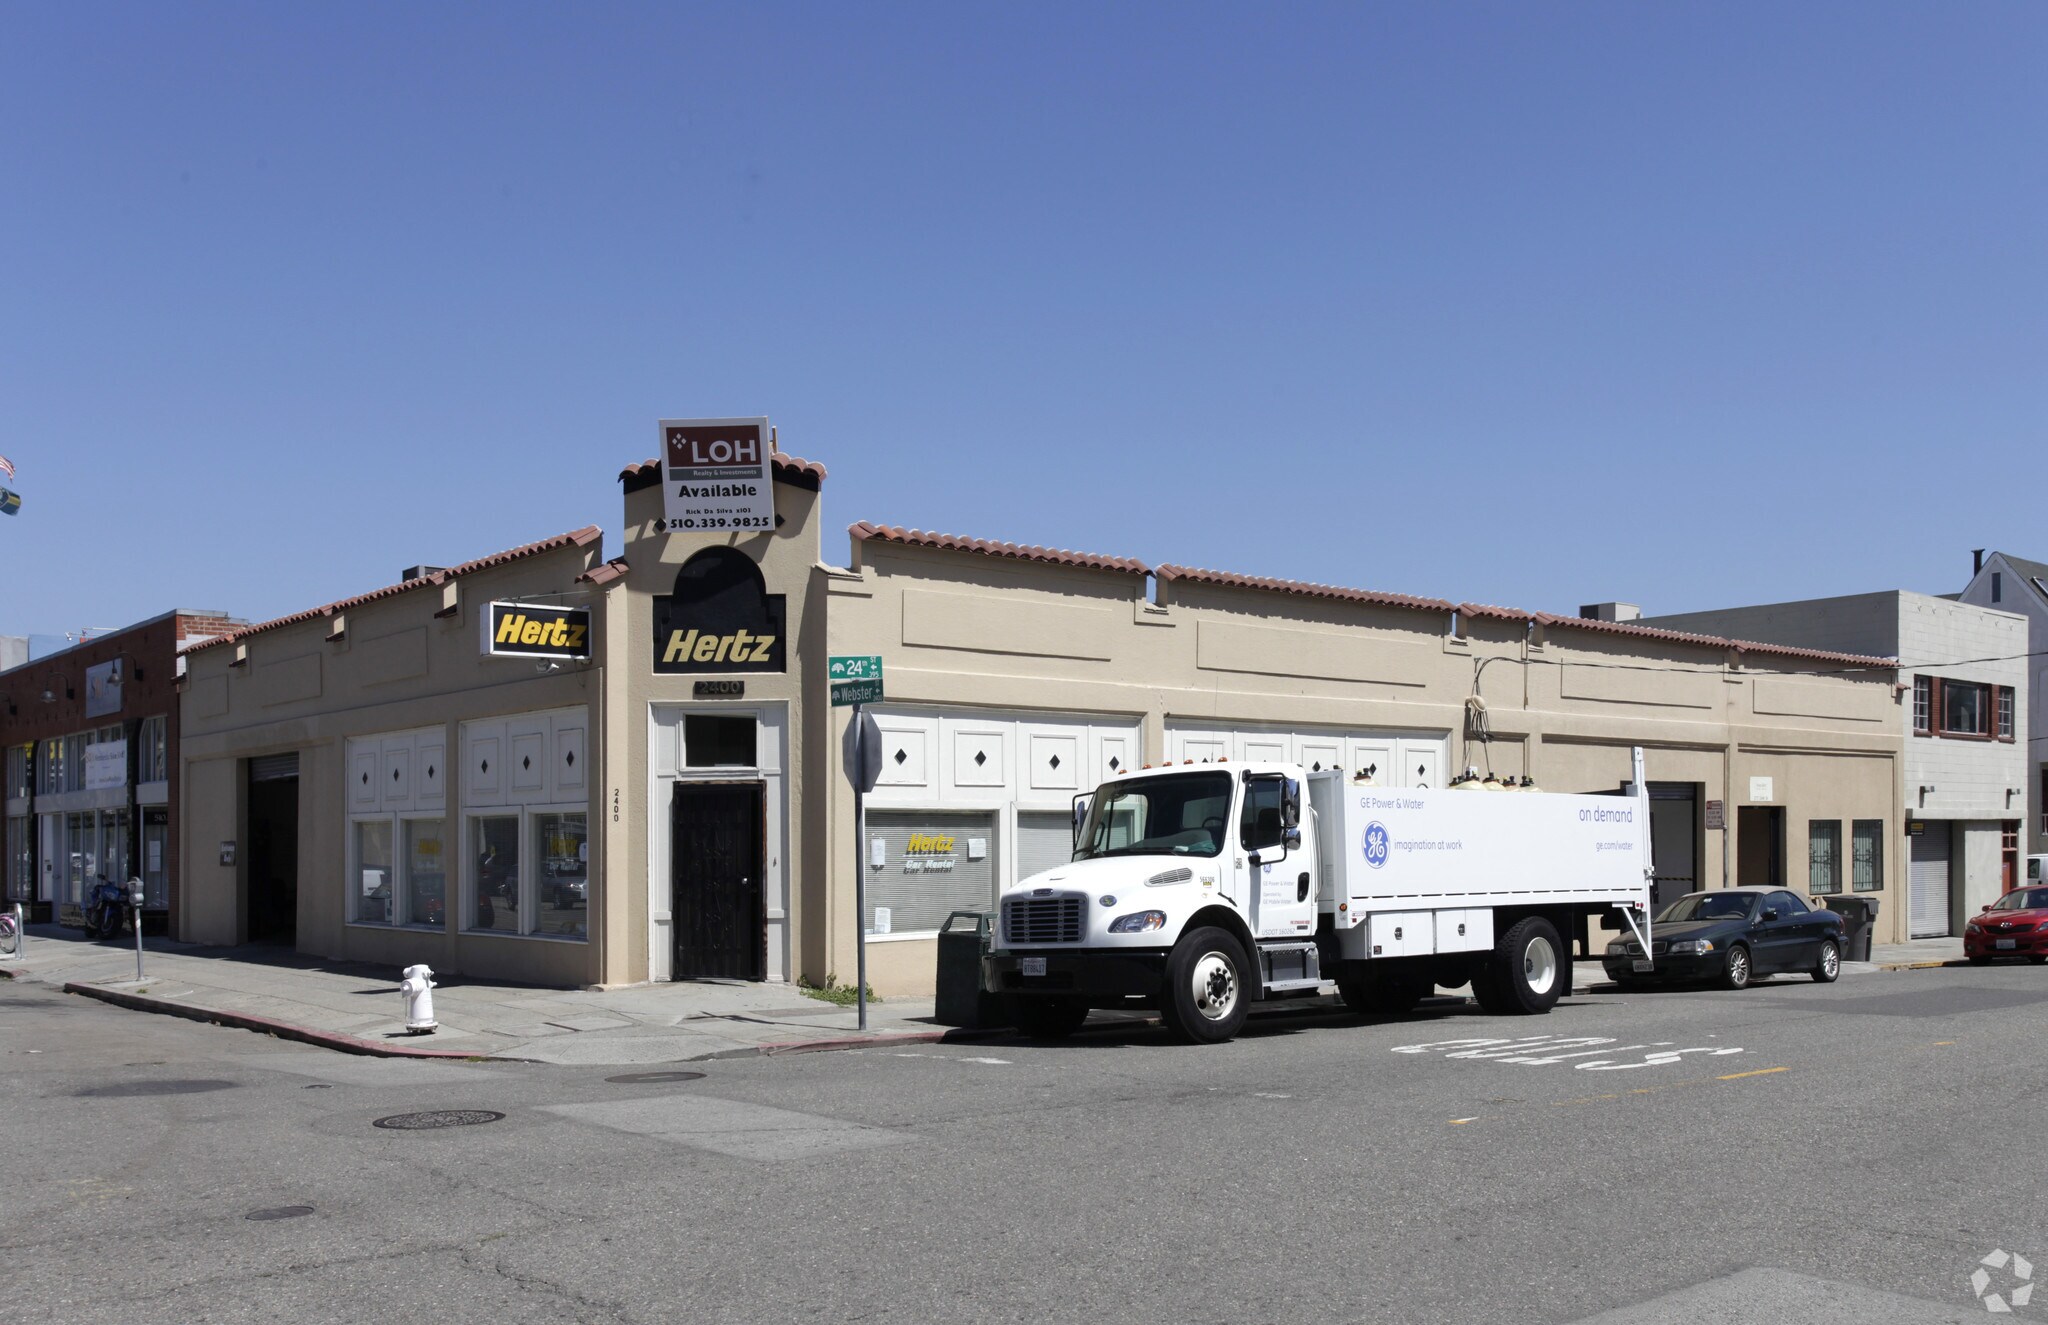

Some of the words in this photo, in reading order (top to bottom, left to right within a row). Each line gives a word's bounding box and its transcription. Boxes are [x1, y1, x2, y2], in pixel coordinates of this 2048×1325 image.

[692, 440, 757, 463] LOH
[678, 484, 757, 498] Available
[670, 517, 769, 528] 510.339.9825
[495, 613, 587, 647] Hertz
[662, 629, 776, 663] Hertz
[700, 681, 740, 694] 2400
[841, 686, 872, 702] Webster
[1360, 797, 1370, 808] GE
[1372, 797, 1395, 809] Power
[1396, 798, 1401, 809] &
[1402, 798, 1424, 809] Water
[1579, 809, 1591, 821] on
[1594, 805, 1632, 823] demand
[908, 833, 955, 852] Hertz
[1394, 839, 1436, 853] imagination
[1437, 841, 1445, 850] at
[1446, 840, 1463, 850] work
[1595, 840, 1633, 852] ge.com/water
[905, 860, 922, 869] Car
[925, 859, 956, 869] Rental
